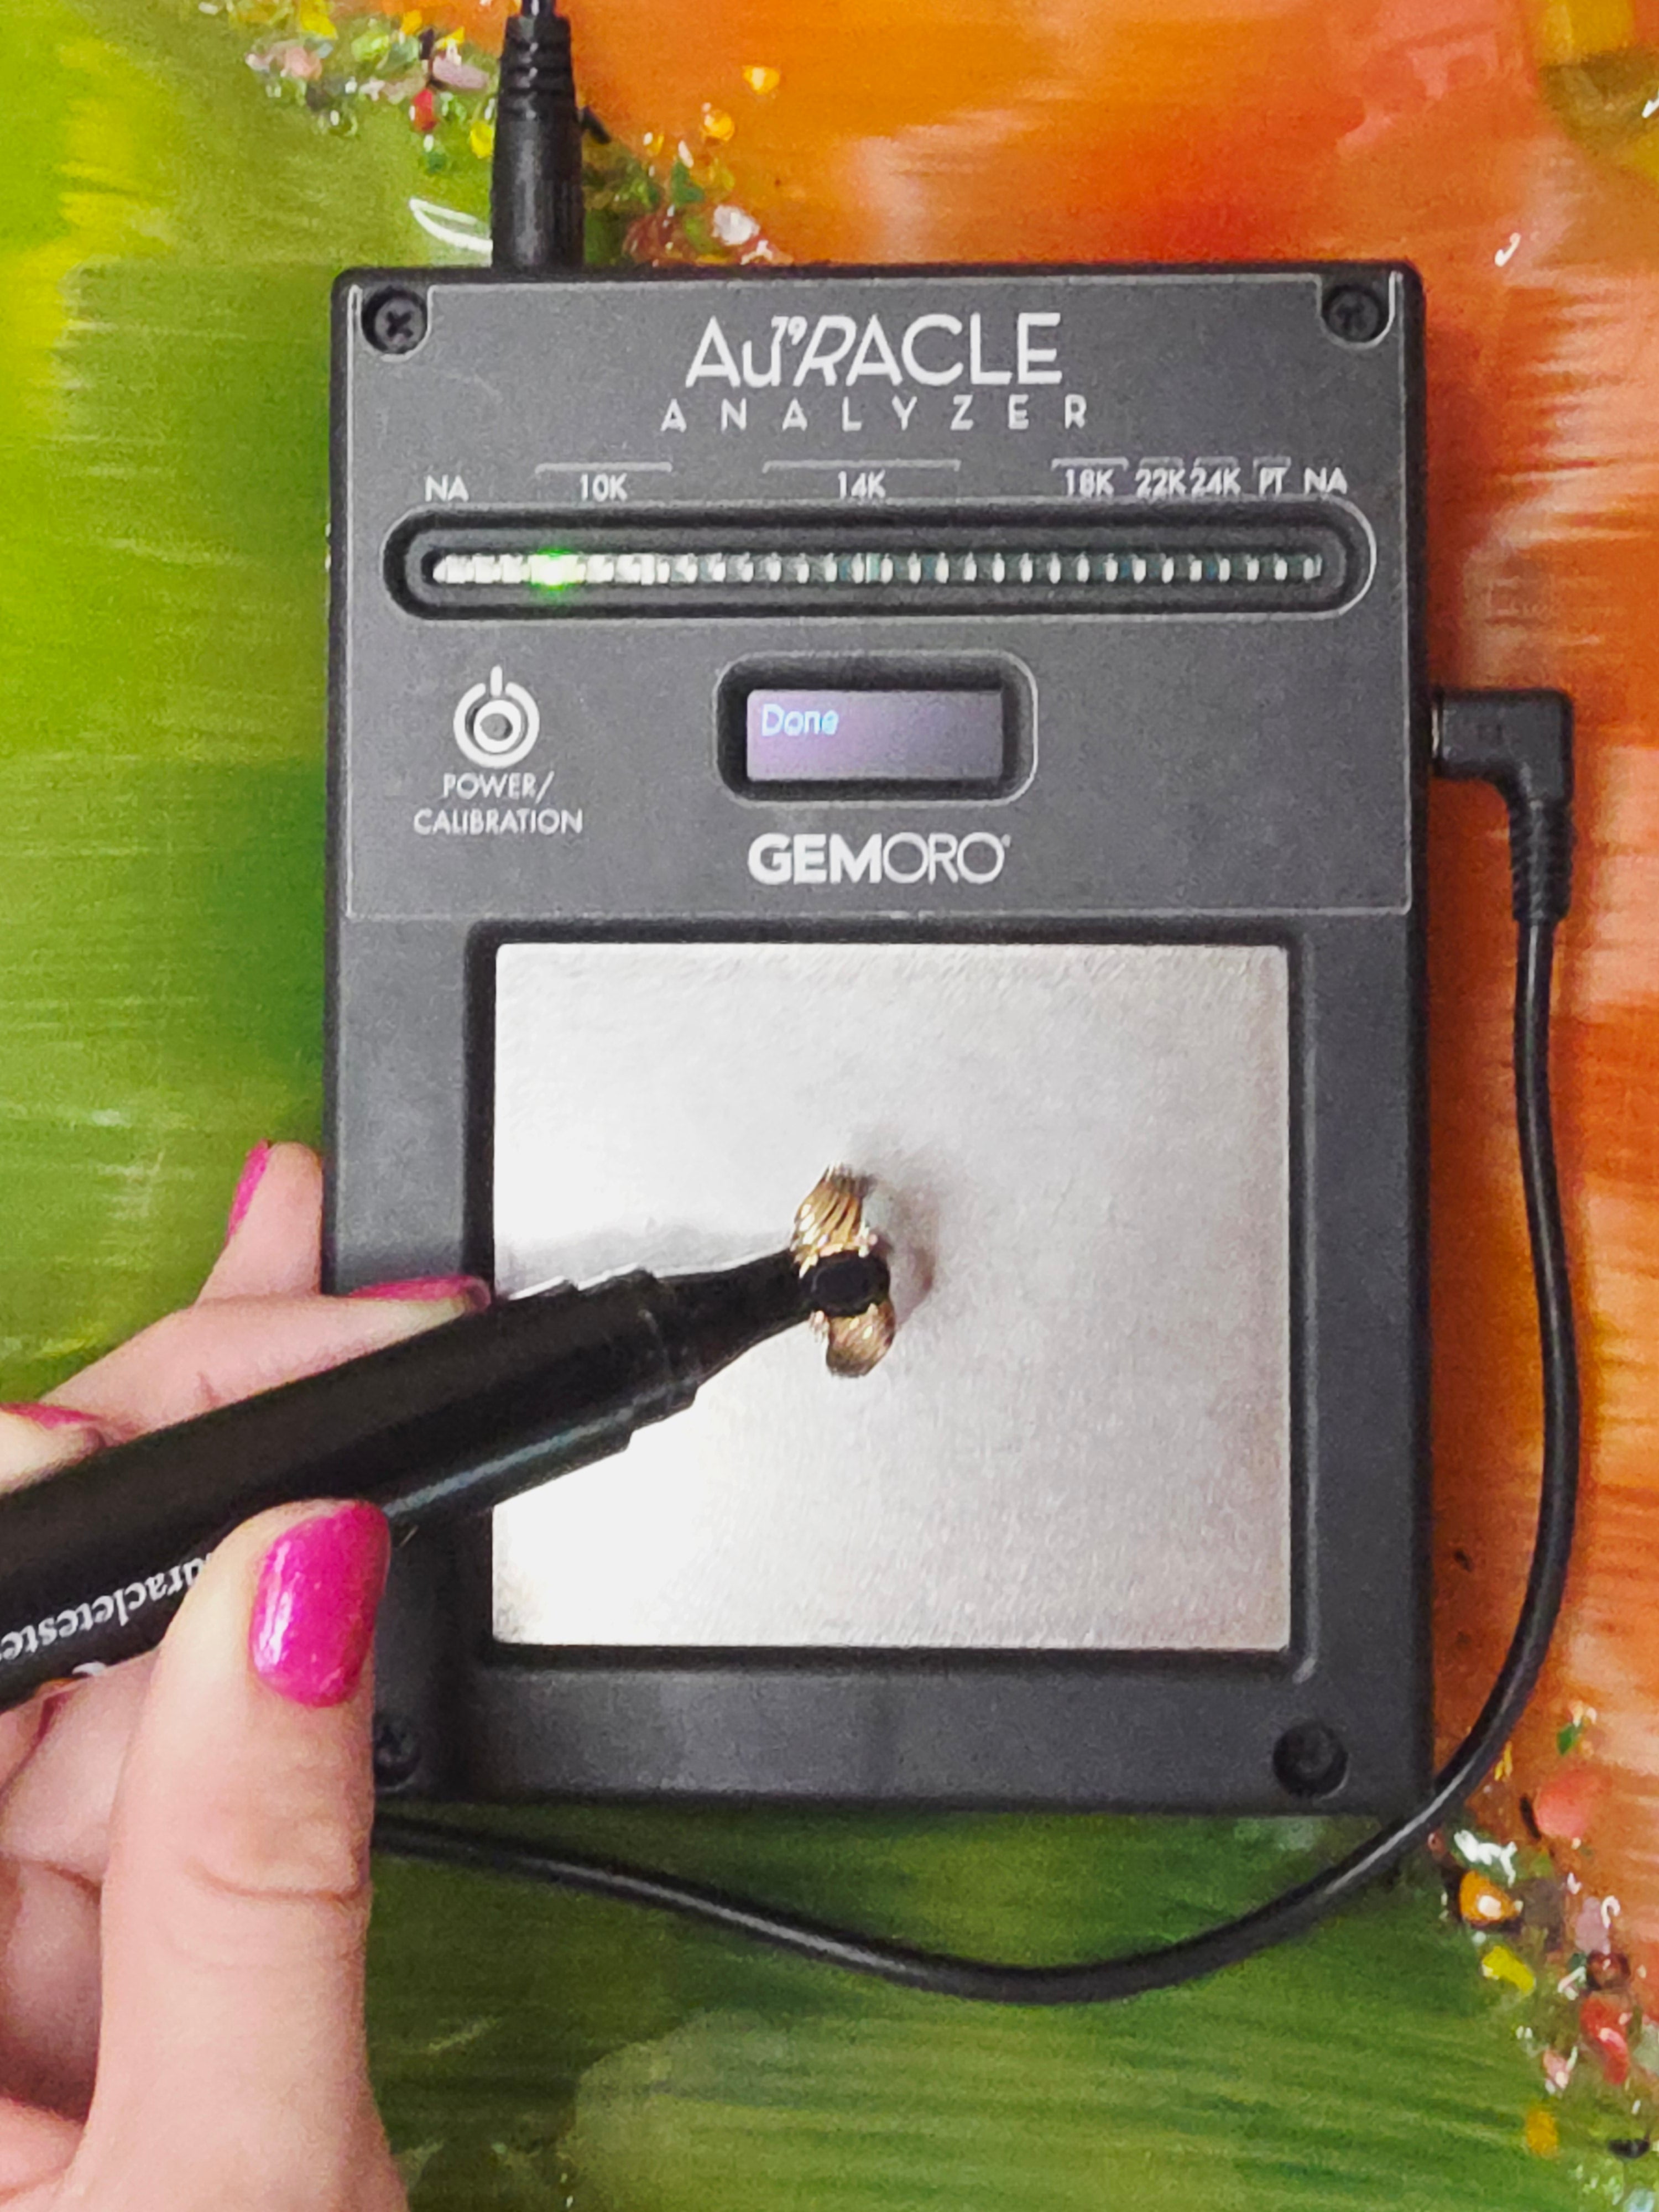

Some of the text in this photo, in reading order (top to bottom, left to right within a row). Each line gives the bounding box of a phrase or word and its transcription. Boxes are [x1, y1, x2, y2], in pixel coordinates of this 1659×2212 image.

[661, 395, 1087, 432] ANALYZER
[425, 468, 1348, 502] NA 10K 14K 18K 22K 24K PT NA
[761, 704, 839, 736] Done
[443, 771, 555, 804] POWER/
[414, 808, 583, 835] CALIBRATION
[748, 832, 1005, 885] GEMORO
[0, 1552, 213, 1661] uracleteste
